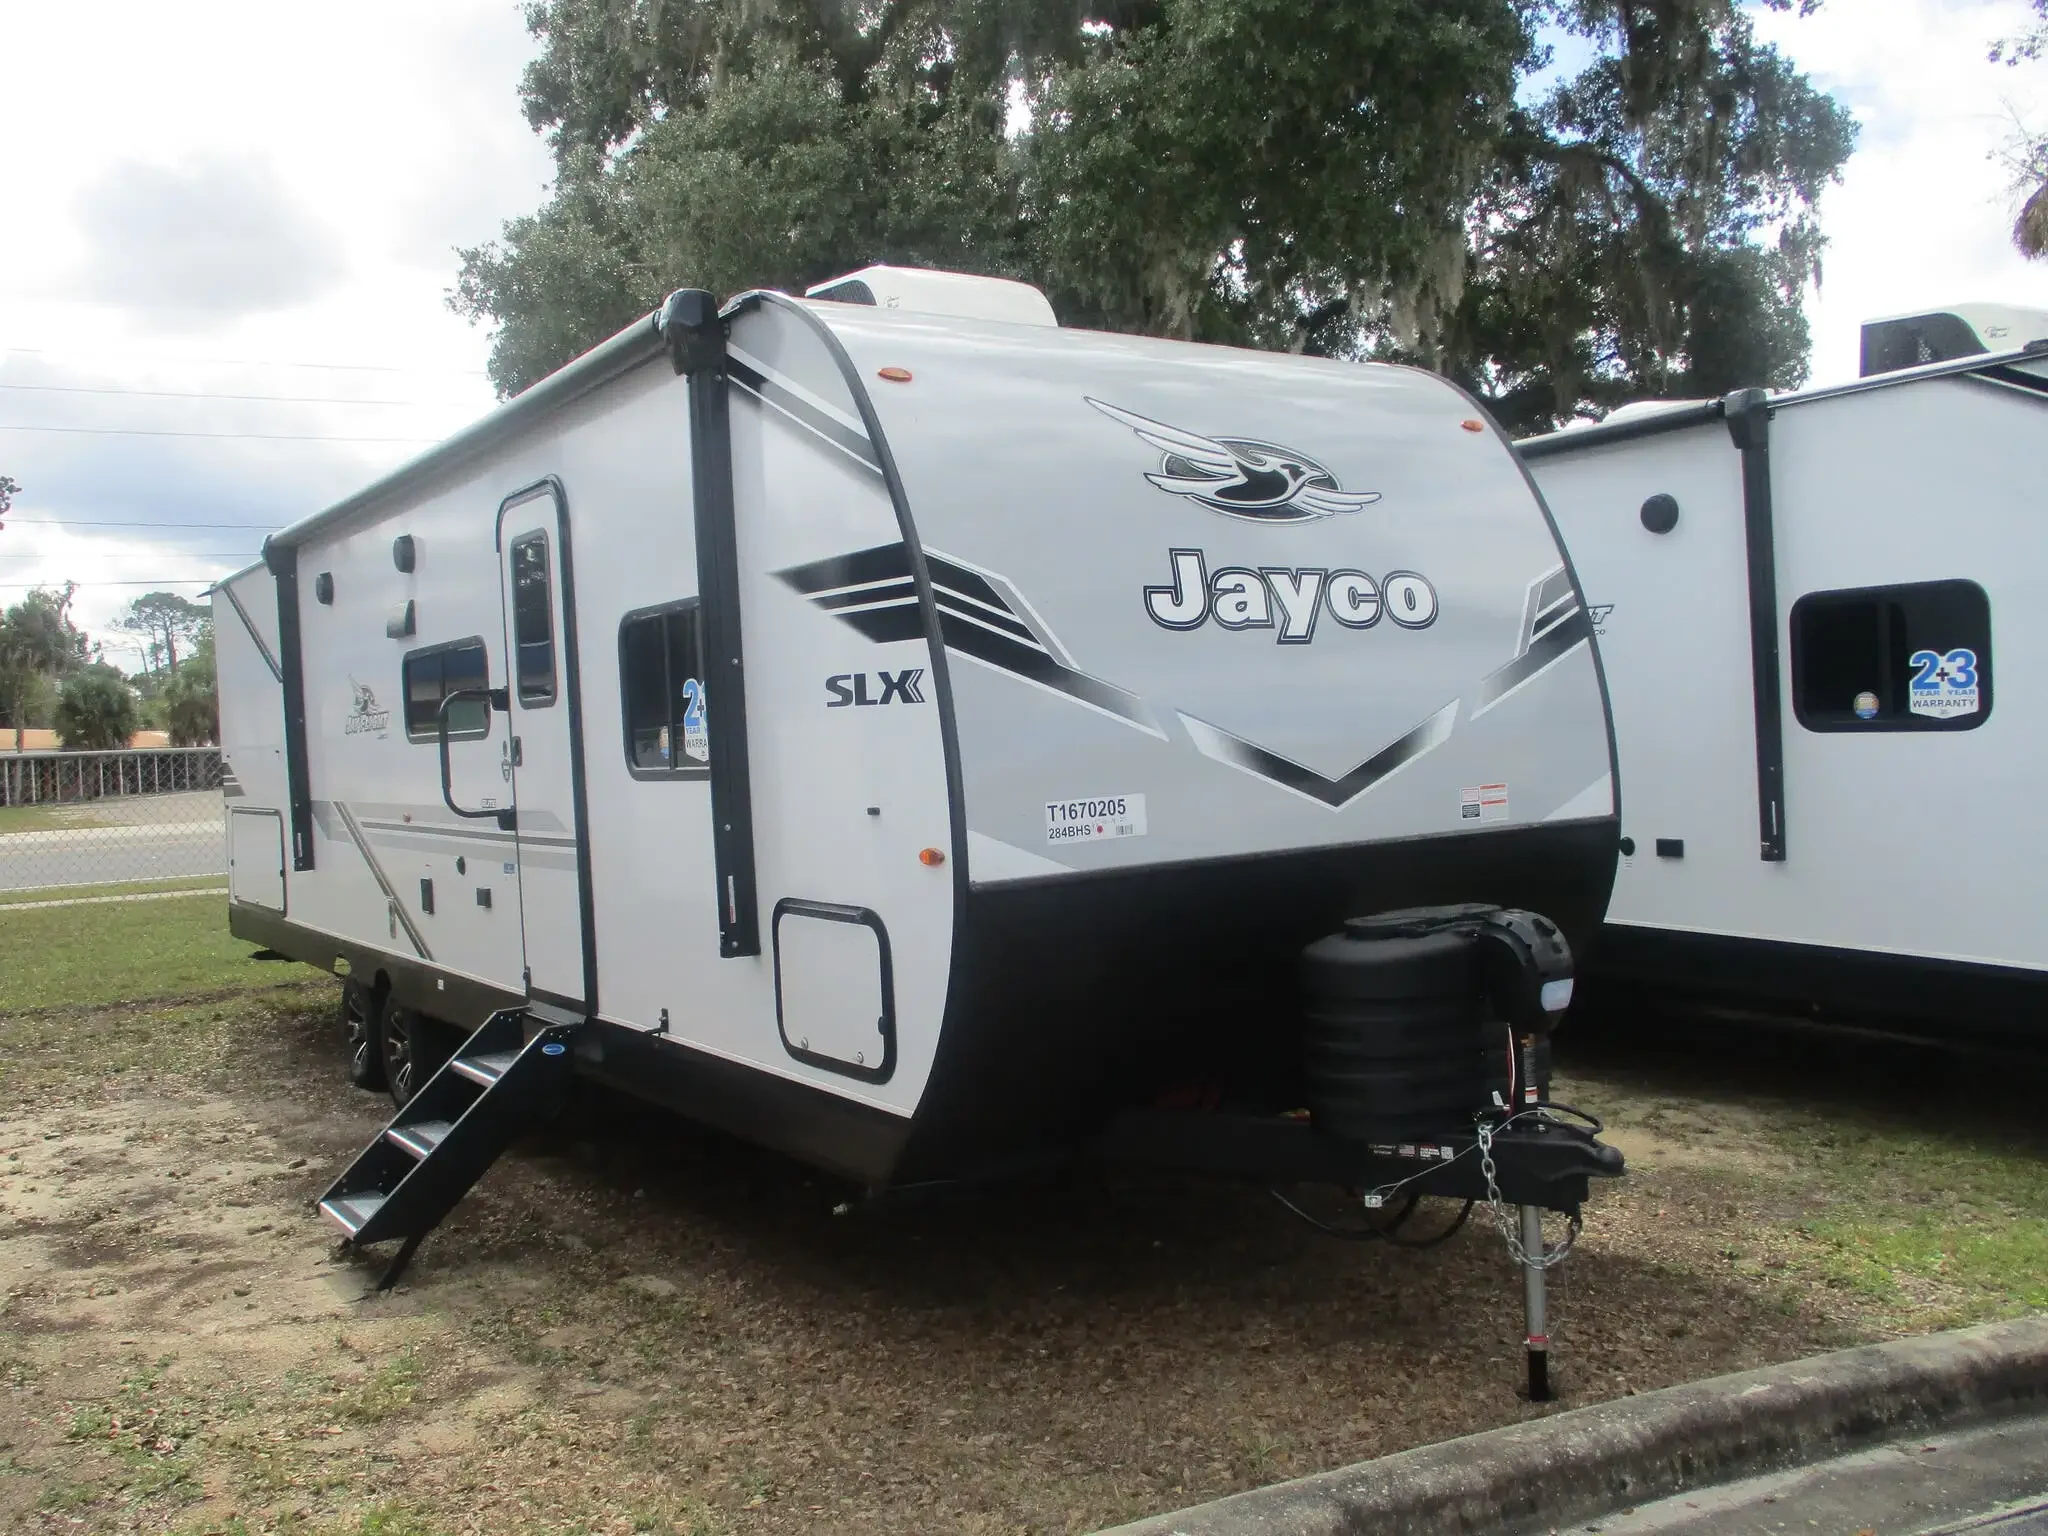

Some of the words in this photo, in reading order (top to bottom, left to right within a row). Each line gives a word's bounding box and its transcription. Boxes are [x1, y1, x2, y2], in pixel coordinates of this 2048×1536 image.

[1143, 547, 1440, 645] Jayco
[825, 668, 926, 708] SLX
[1946, 688, 1976, 696] YEAR
[684, 679, 707, 727] 2+
[1912, 699, 1976, 708] WARRANTY
[686, 738, 708, 749] WARRA
[1046, 798, 1127, 822] T1670205
[1048, 824, 1091, 840] 284BHS
